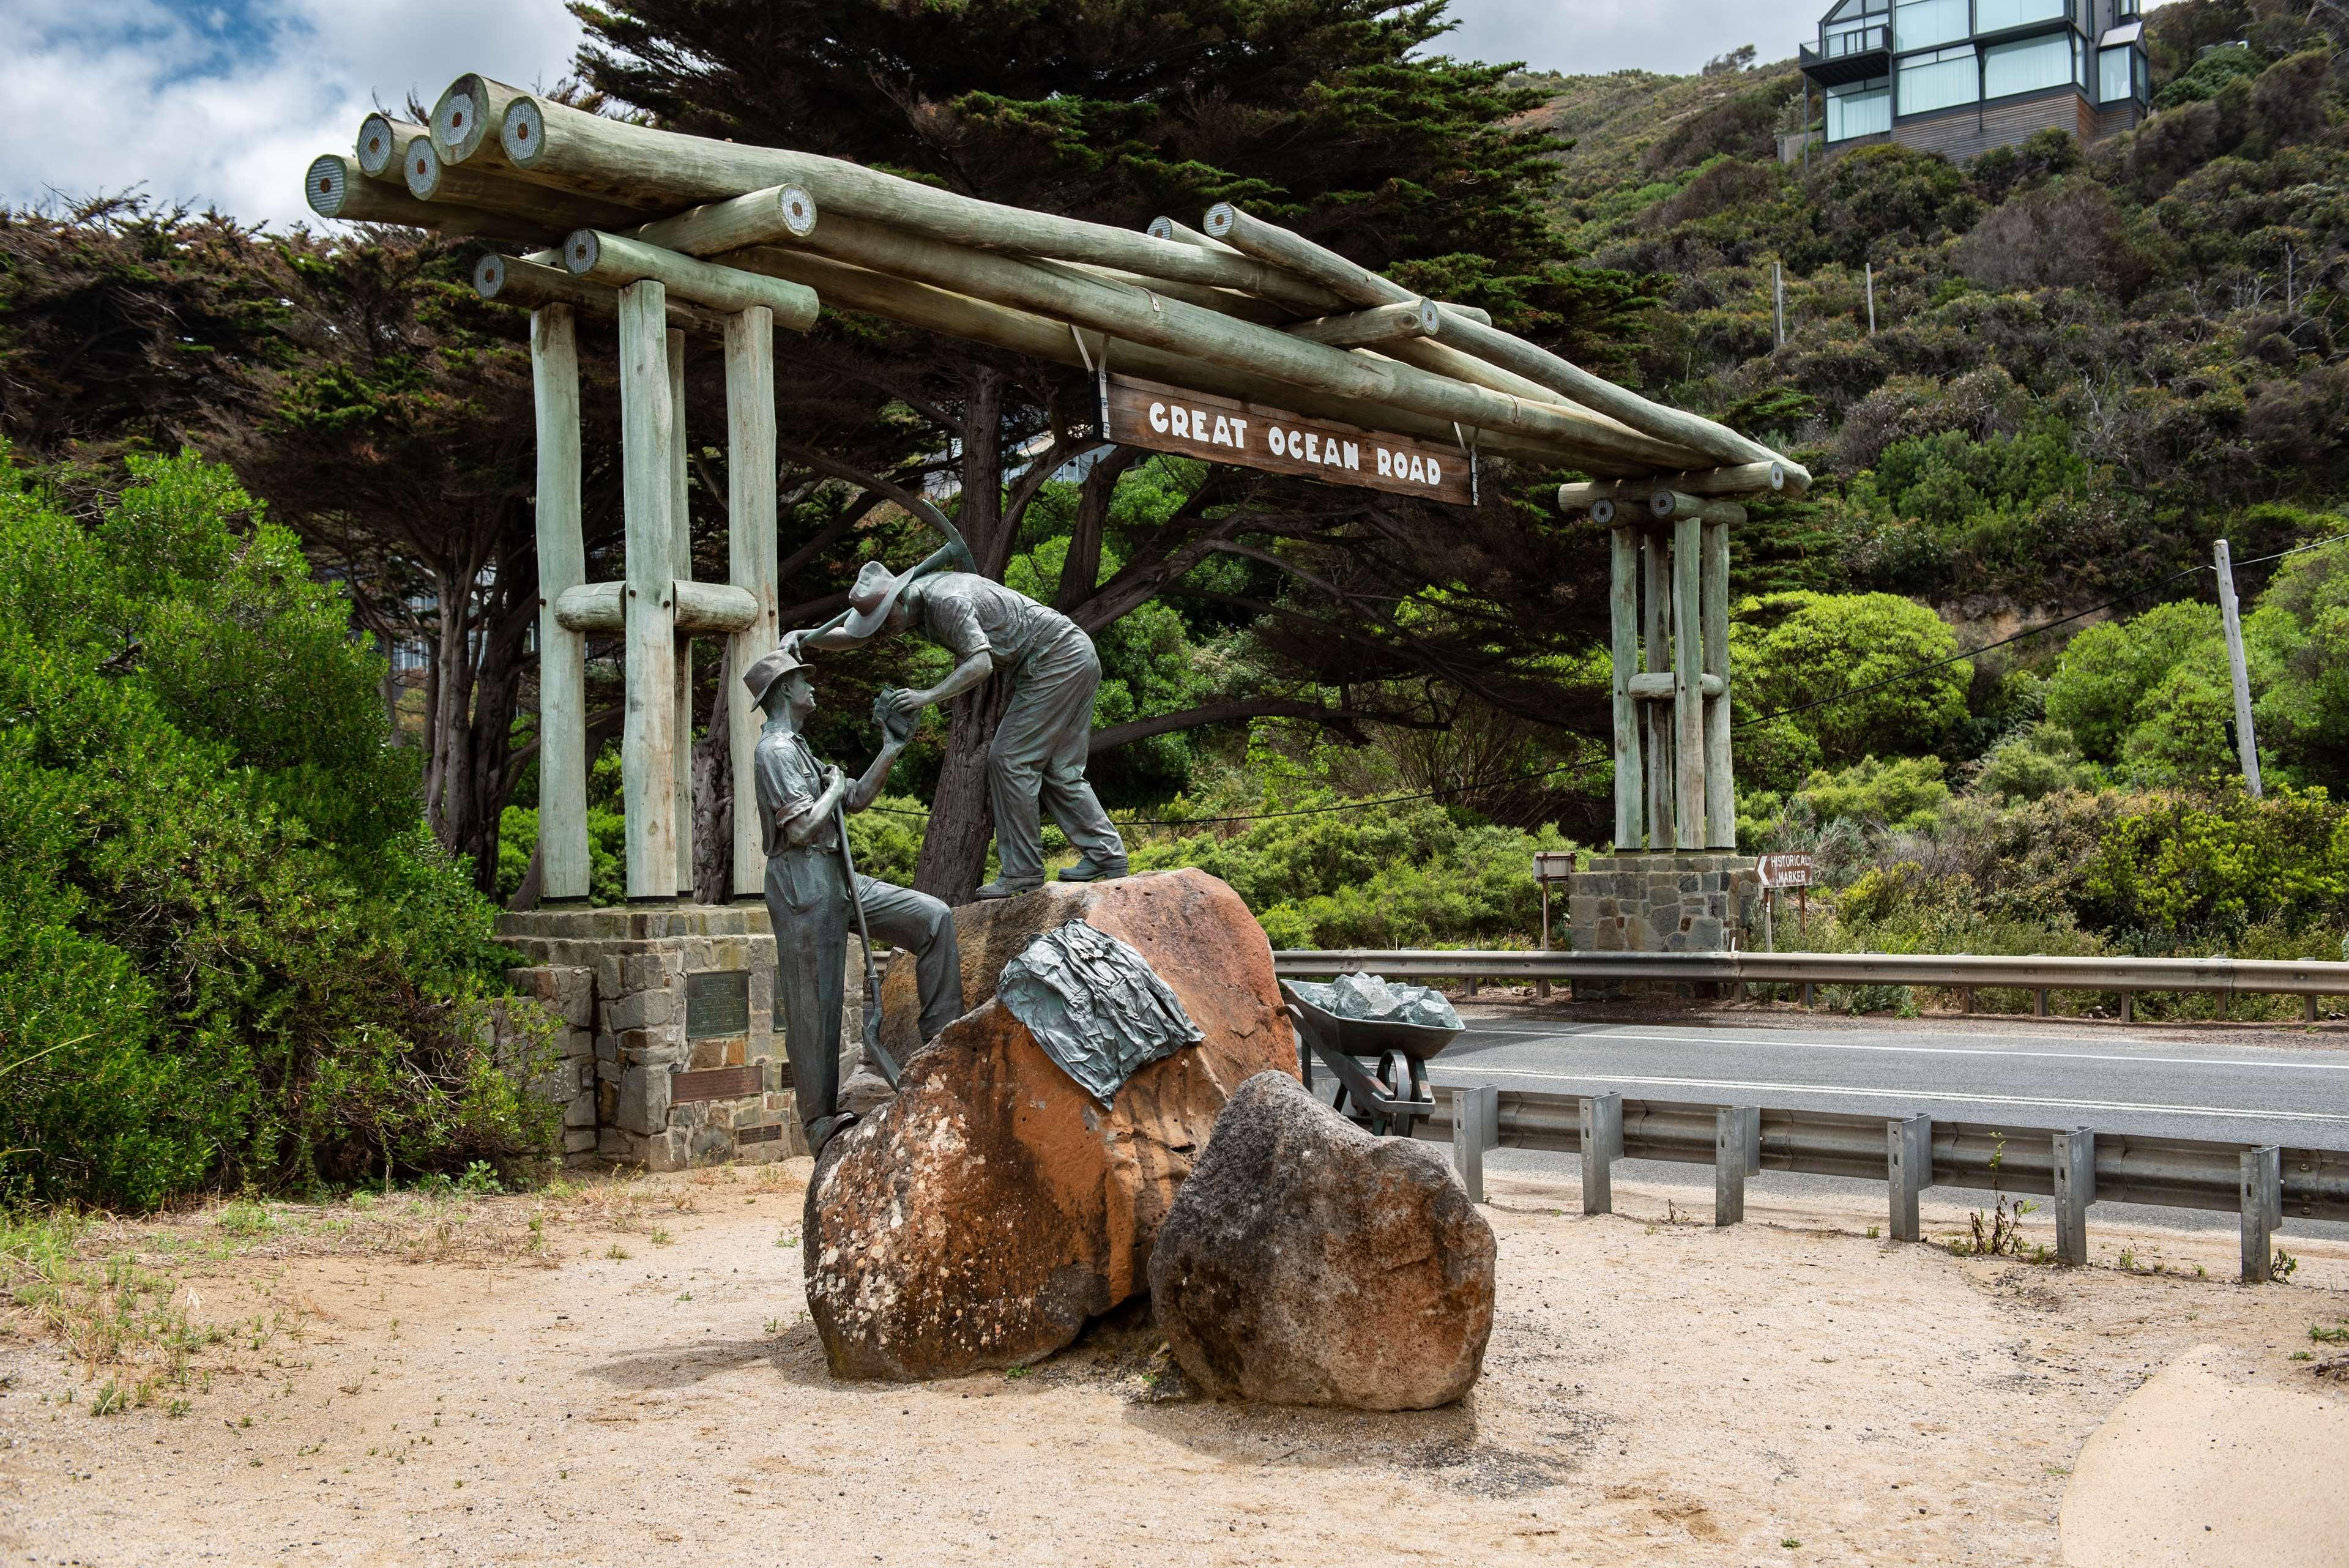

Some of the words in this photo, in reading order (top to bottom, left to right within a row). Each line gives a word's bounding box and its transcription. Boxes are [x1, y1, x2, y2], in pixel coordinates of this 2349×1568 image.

[1149, 402, 1248, 448] GREAT
[1268, 426, 1359, 470] OCEAN
[1377, 448, 1441, 485] ROAD
[1771, 855, 1809, 868] HISTORICAL
[1778, 871, 1806, 883] MARKER
